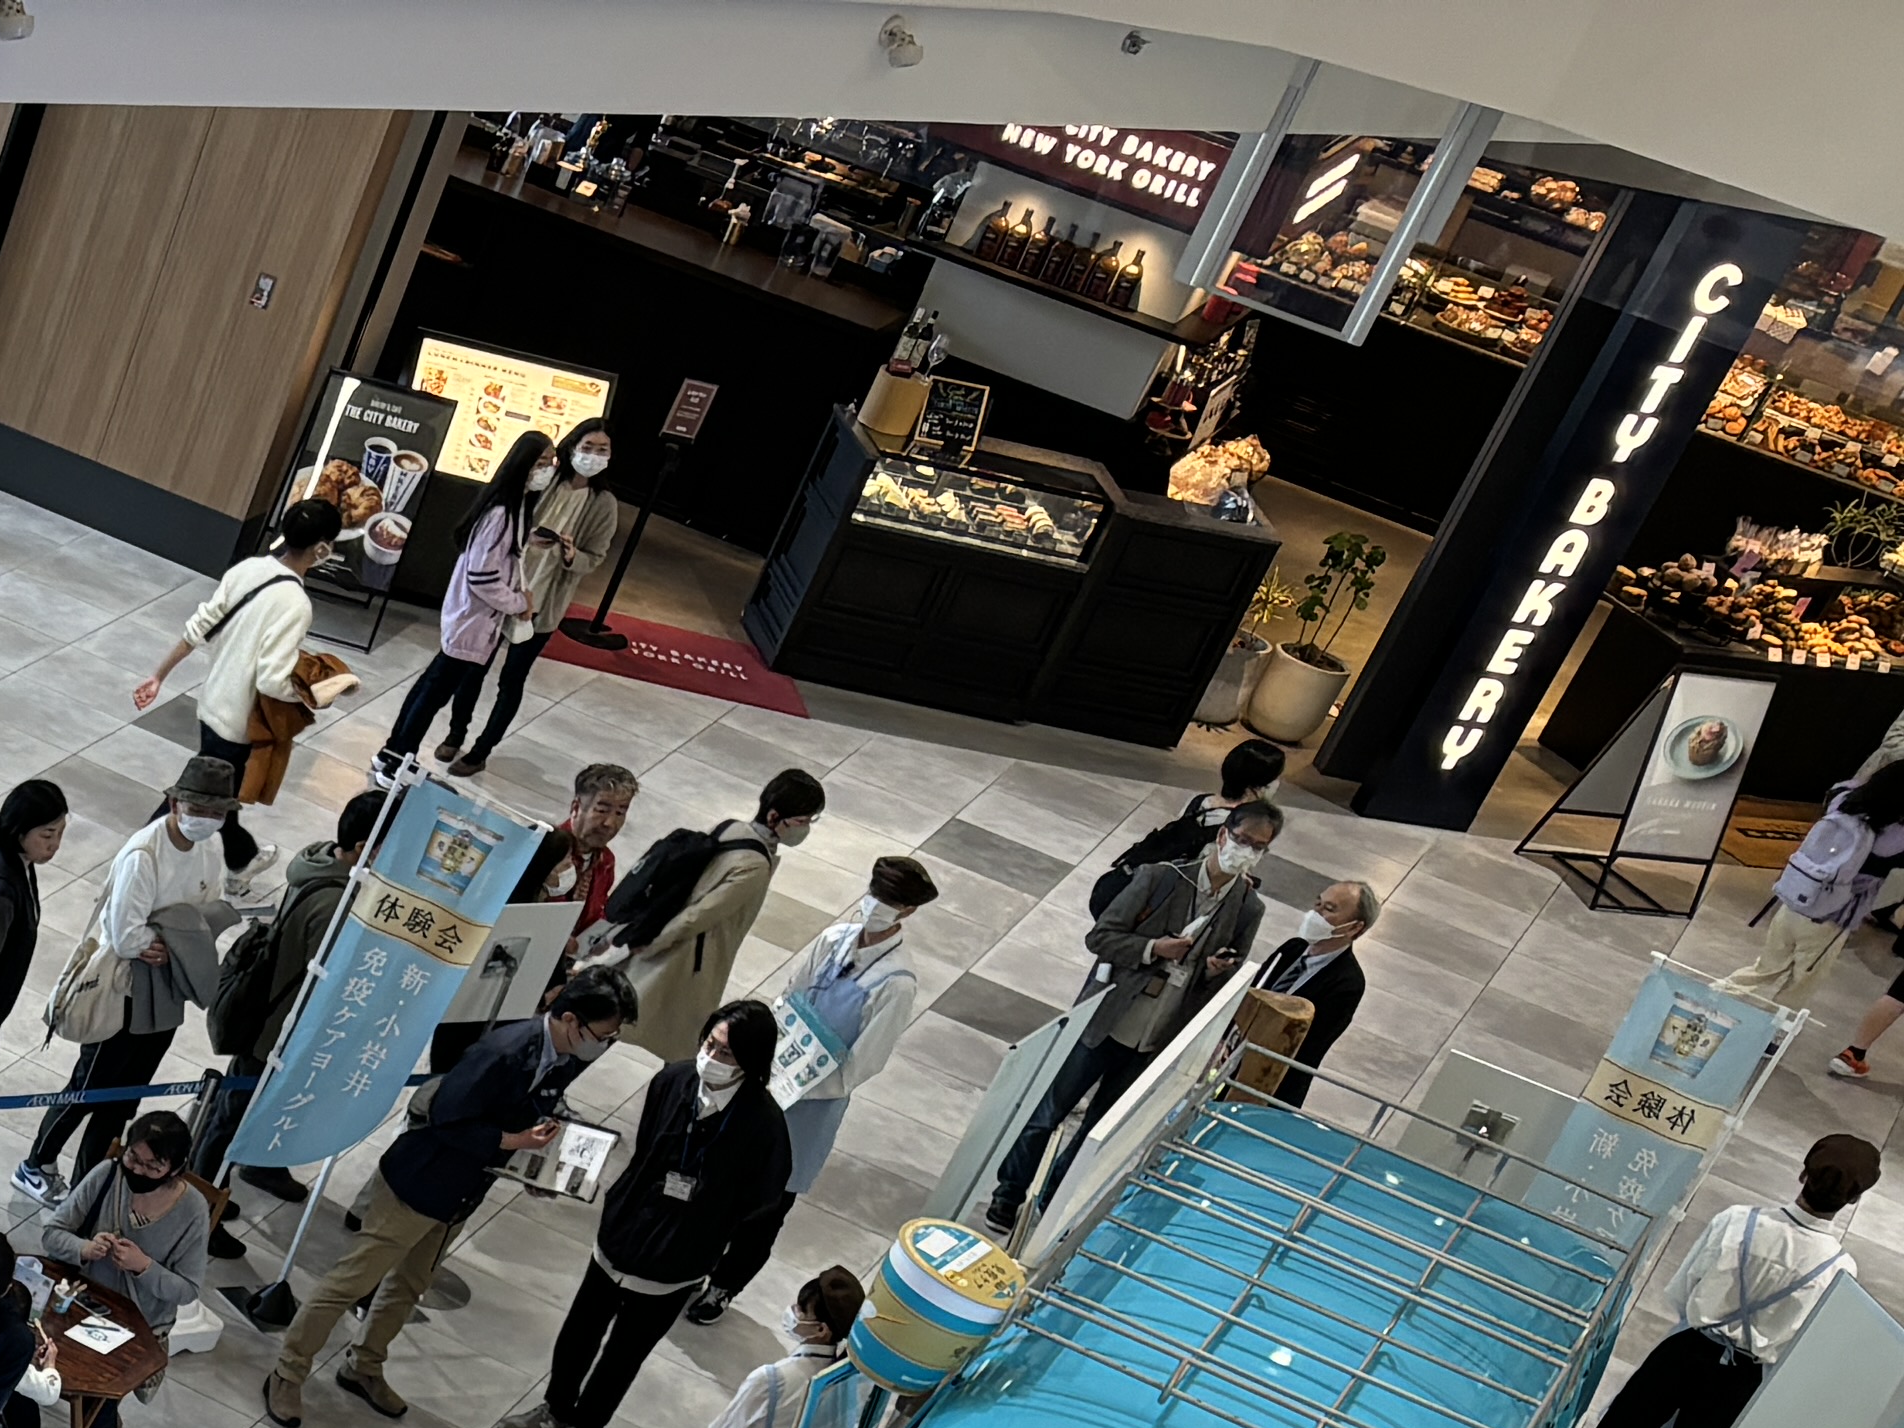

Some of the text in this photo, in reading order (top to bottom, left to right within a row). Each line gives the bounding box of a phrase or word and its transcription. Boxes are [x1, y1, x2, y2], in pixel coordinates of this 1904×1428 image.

[1001, 123, 1203, 207] NEW YORK GRILL
[1121, 135, 1217, 181] BAKERY
[345, 405, 363, 419] THE
[363, 410, 385, 425] CITY
[385, 415, 420, 434] BAKERY
[1441, 262, 1744, 771] CITY BAKERY
[670, 649, 743, 672] BAKERY
[373, 892, 464, 955] 体験会
[267, 946, 390, 1152] 免疫ケアヨーグルト
[341, 963, 431, 1098] 新・小岩井
